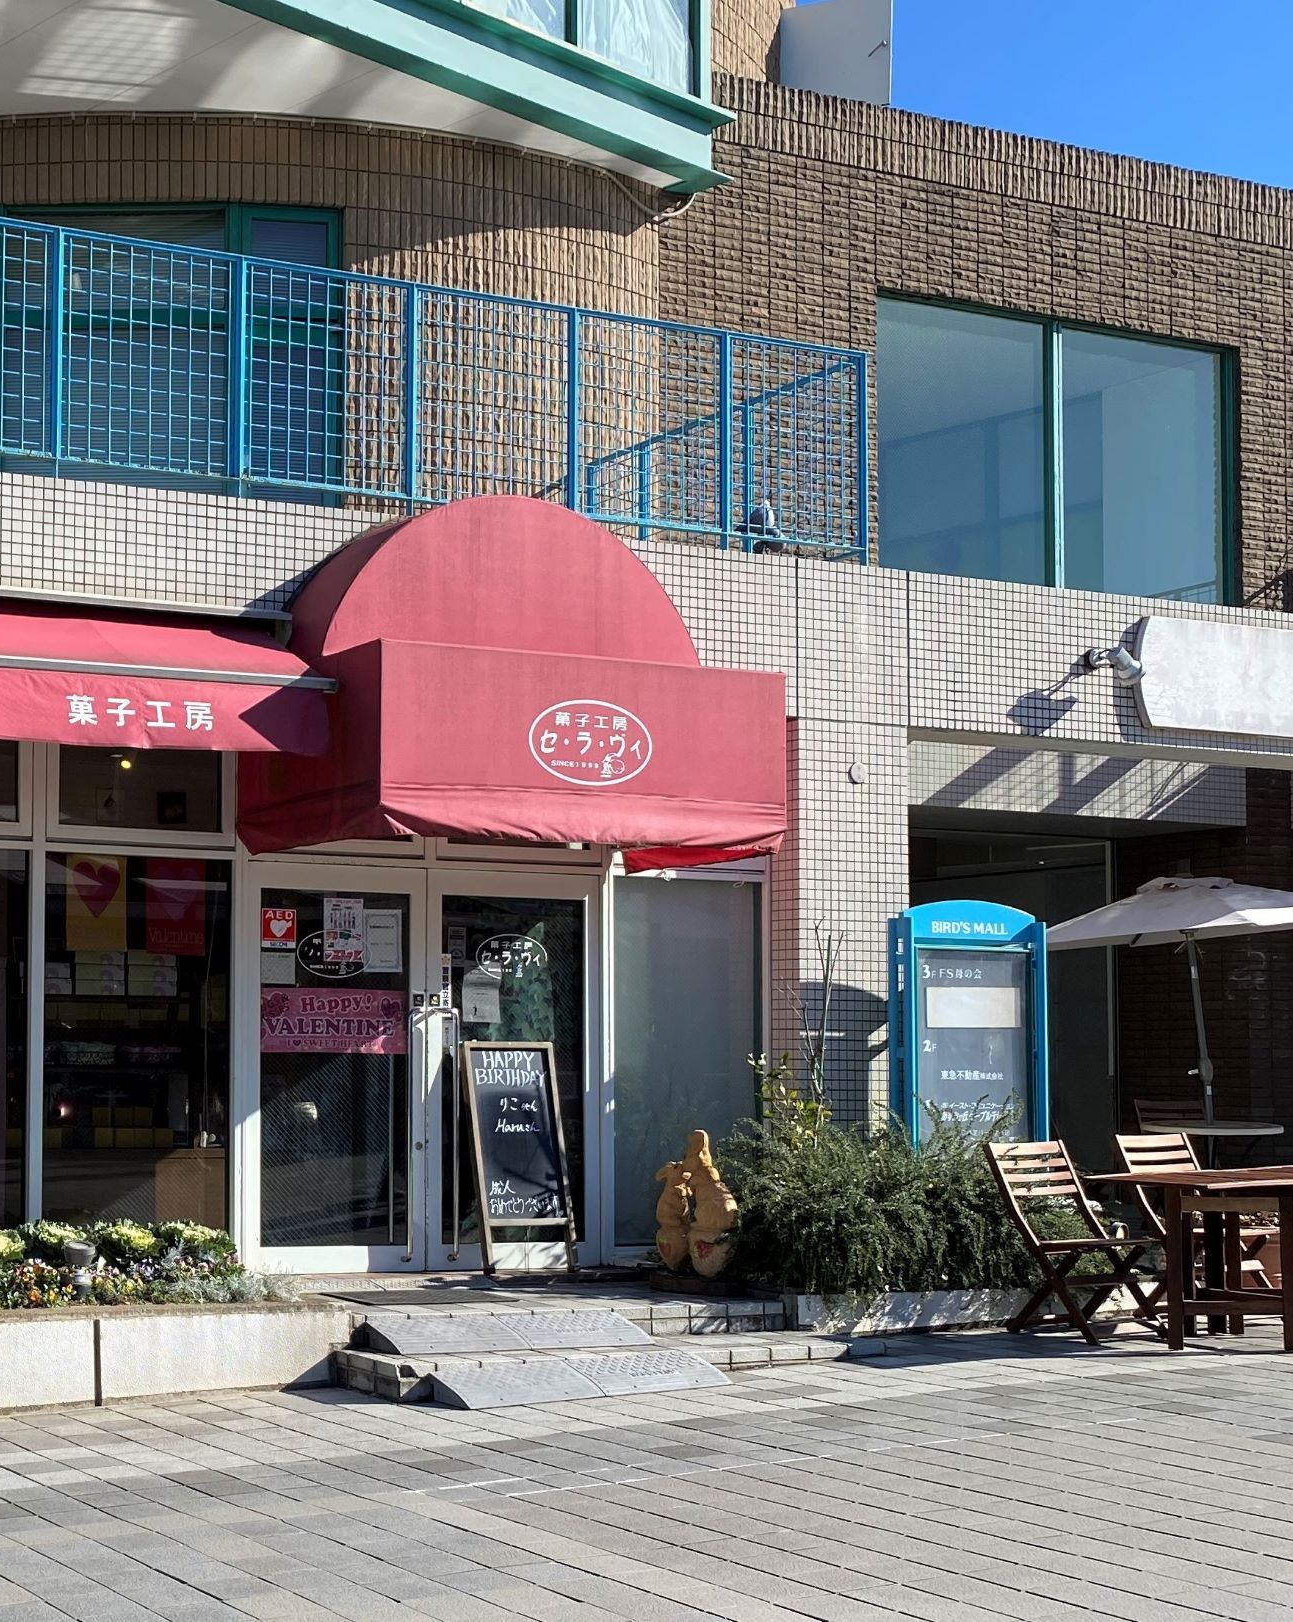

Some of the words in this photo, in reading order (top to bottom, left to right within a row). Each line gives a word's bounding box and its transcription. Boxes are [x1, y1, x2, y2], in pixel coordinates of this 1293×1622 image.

[65, 694, 215, 732] 菓子工房
[555, 711, 628, 731] 菓子工房
[265, 910, 293, 920] AED
[148, 927, 204, 945] Valentine
[931, 920, 971, 934] BIRD'S
[973, 922, 1008, 935] MALL
[922, 964, 937, 979] 3F
[300, 994, 372, 1014] Happy!
[264, 1017, 395, 1037] VALENTINE
[922, 1039, 937, 1053] 2F
[481, 1050, 535, 1072] HAPPY
[474, 1067, 547, 1088] BIRTHDAY
[940, 1070, 1005, 1080] 東急不動産株式会社
